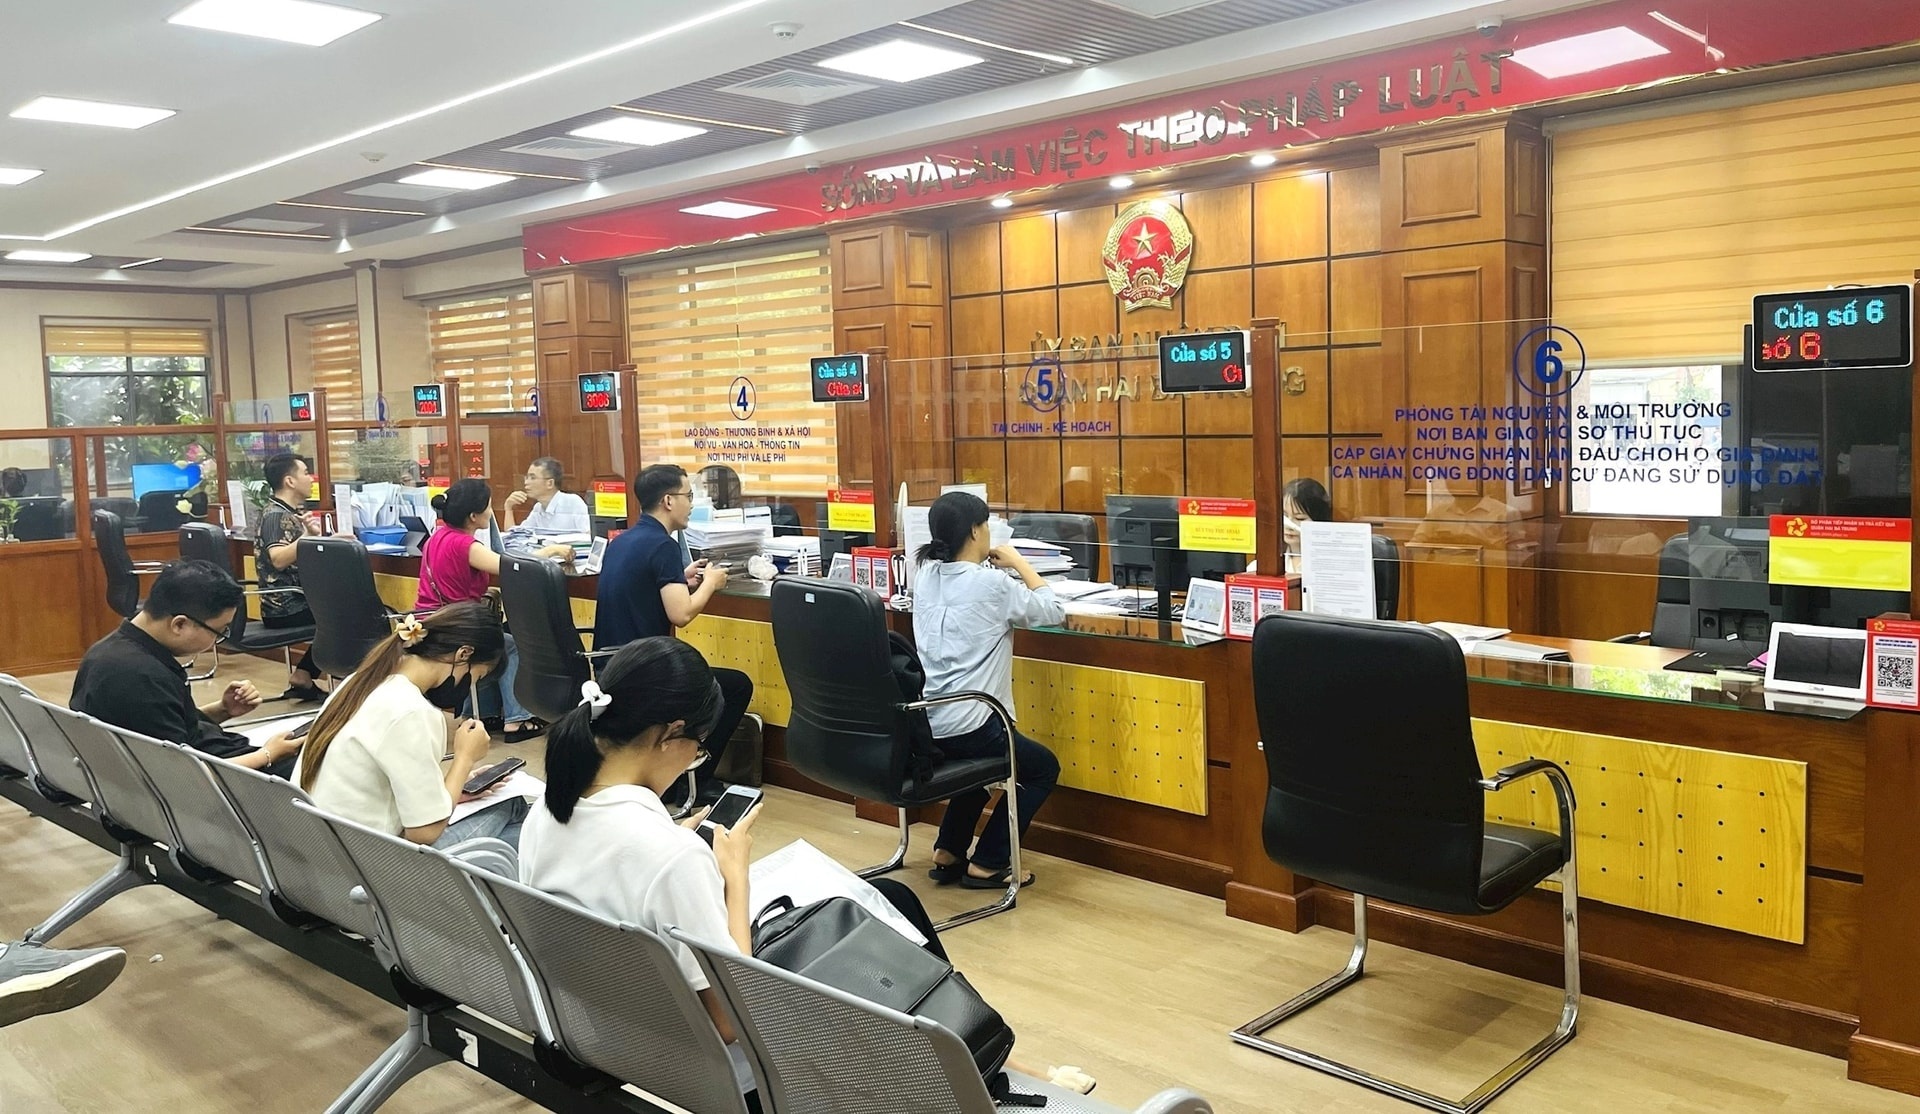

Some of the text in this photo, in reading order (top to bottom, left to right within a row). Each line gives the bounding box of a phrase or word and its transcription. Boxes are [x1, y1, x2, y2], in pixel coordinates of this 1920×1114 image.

[821, 47, 1514, 212] SỐNG VÀ LÀM VIỆC THEO PHÁP LUẬT
[1774, 298, 1885, 329] Cửa số 6
[1070, 333, 1124, 360] BAN
[1170, 341, 1232, 363] Cửa số 5
[1800, 331, 1821, 360] 6
[836, 362, 847, 377] số
[849, 362, 857, 376] 4
[1535, 340, 1563, 384] 6
[433, 389, 438, 400] 2
[605, 380, 610, 392] 3
[1037, 369, 1053, 401] 5
[1096, 375, 1141, 402] HAI
[530, 394, 539, 416] 3
[736, 386, 748, 412] 4
[1460, 404, 1486, 421] TÀI
[1576, 405, 1589, 420] &
[1595, 402, 1630, 419] MÔI
[1638, 399, 1731, 418] TRƯỜNG
[684, 428, 698, 437] LAO
[777, 428, 783, 436] &
[797, 426, 811, 438] HỘI
[1417, 428, 1446, 440] NƠI
[1452, 427, 1488, 440] BAN
[1495, 426, 1538, 440] GIAO
[1578, 425, 1607, 439] SƠ
[1613, 421, 1652, 440] THỦ
[1660, 424, 1702, 444] TỤC
[788, 441, 800, 449] TIN
[1412, 443, 1475, 460] CHỨNG
[1481, 445, 1530, 464] NHẬN
[1716, 447, 1754, 462] GIA
[707, 453, 720, 461] NƠI
[722, 453, 735, 461] THU
[1570, 467, 1598, 482] CƯ
[1604, 468, 1661, 483] ĐANG
[1669, 465, 1700, 484] SỬ
